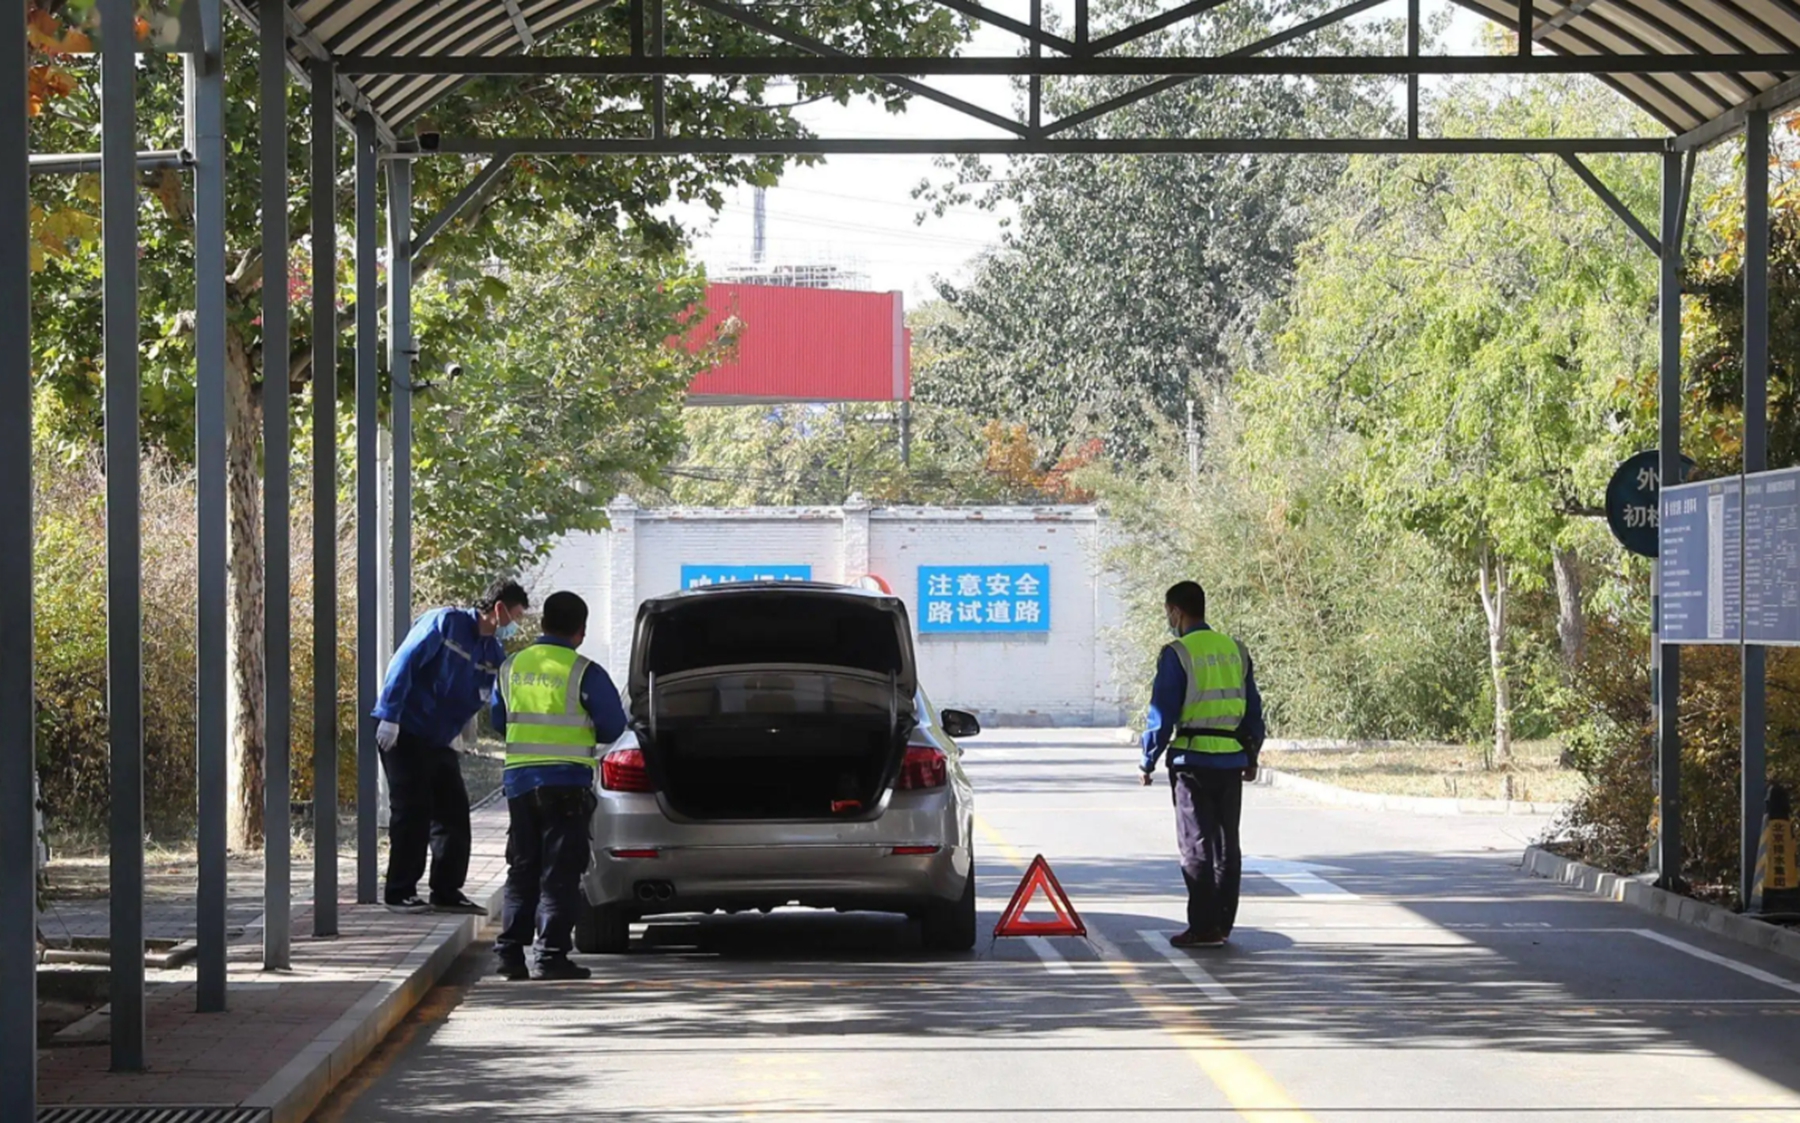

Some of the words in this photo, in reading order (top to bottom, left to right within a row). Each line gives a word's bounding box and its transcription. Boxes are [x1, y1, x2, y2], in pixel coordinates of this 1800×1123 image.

[928, 573, 1039, 596] 注意安全
[928, 600, 1040, 623] 路试道路
